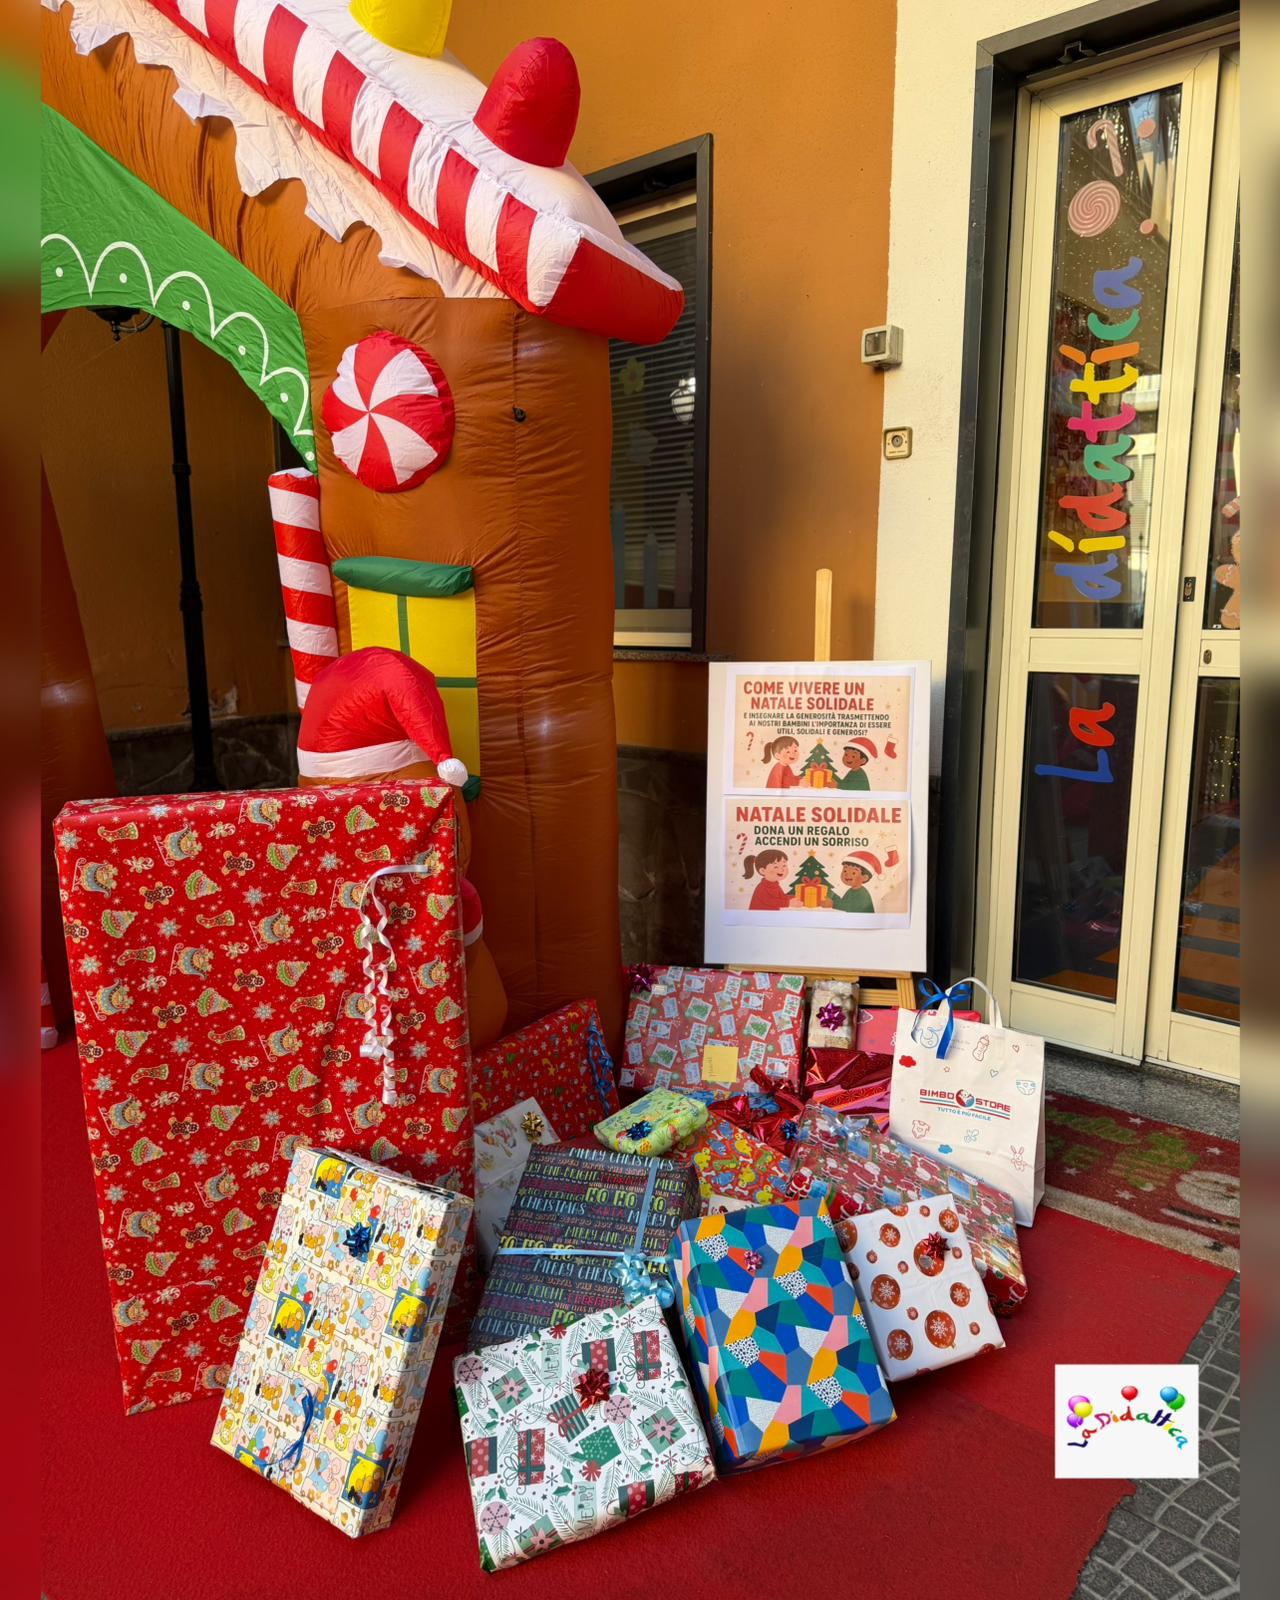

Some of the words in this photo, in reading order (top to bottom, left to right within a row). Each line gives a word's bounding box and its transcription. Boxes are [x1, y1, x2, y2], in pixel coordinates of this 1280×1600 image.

[1047, 256, 1145, 600] didattica
[744, 681, 784, 694] COME
[788, 681, 841, 695] VIVERE
[844, 682, 865, 696] UN
[751, 697, 803, 710] NATALE
[806, 698, 875, 711] SOLIDALE
[796, 712, 836, 720] GENEROSITÀ
[777, 728, 795, 736] UTILI,
[1035, 703, 1116, 783] La
[736, 806, 806, 822] NATALE
[811, 807, 902, 823] SOLIDALE
[754, 826, 785, 835] DONA
[788, 826, 804, 835] UN
[807, 826, 850, 836] REGALO
[754, 836, 801, 846] ACCENDI
[804, 837, 820, 846] UN
[822, 837, 869, 847] SORRISO
[920, 1089, 954, 1100] BIMBO
[975, 1098, 1010, 1112] STORE
[972, 1113, 992, 1121] FACILE
[569, 1147, 607, 1162] MERRY
[609, 1152, 674, 1171] CHRISTMAS
[585, 1187, 609, 1205] HO
[613, 1190, 638, 1208] HO
[520, 1196, 588, 1216] CHRISTMAS
[564, 1225, 598, 1241] MERRY
[532, 1258, 575, 1278] MERRY
